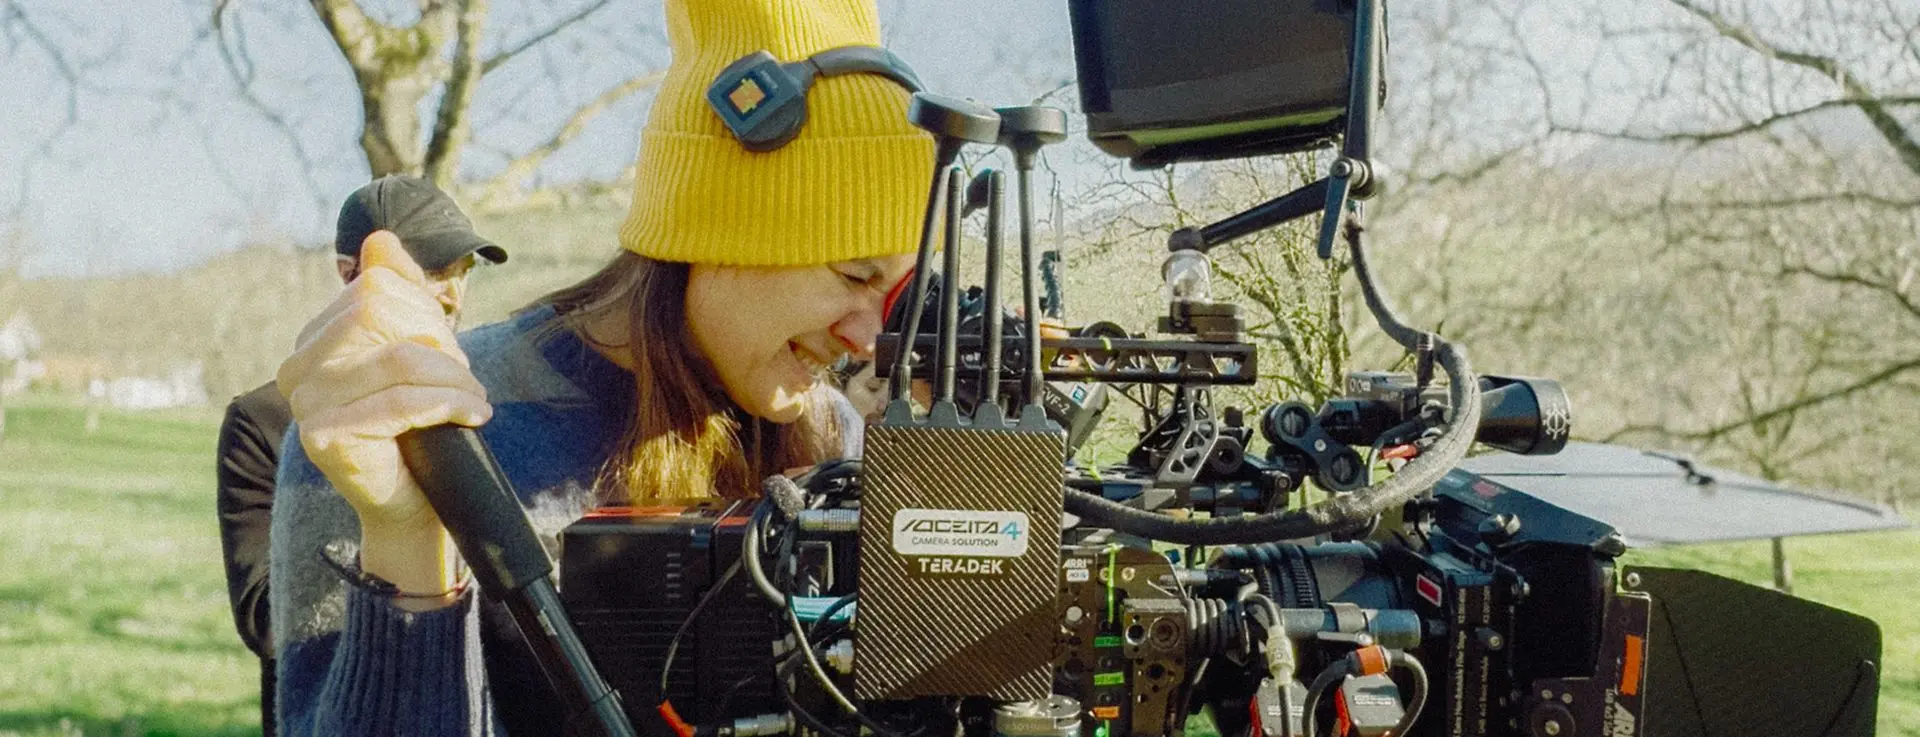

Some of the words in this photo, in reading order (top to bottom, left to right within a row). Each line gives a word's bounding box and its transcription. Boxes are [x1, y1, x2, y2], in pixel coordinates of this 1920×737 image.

[911, 537, 950, 546] CAMERA
[951, 538, 998, 547] SOLUTION
[918, 558, 1003, 574] TERADEK
